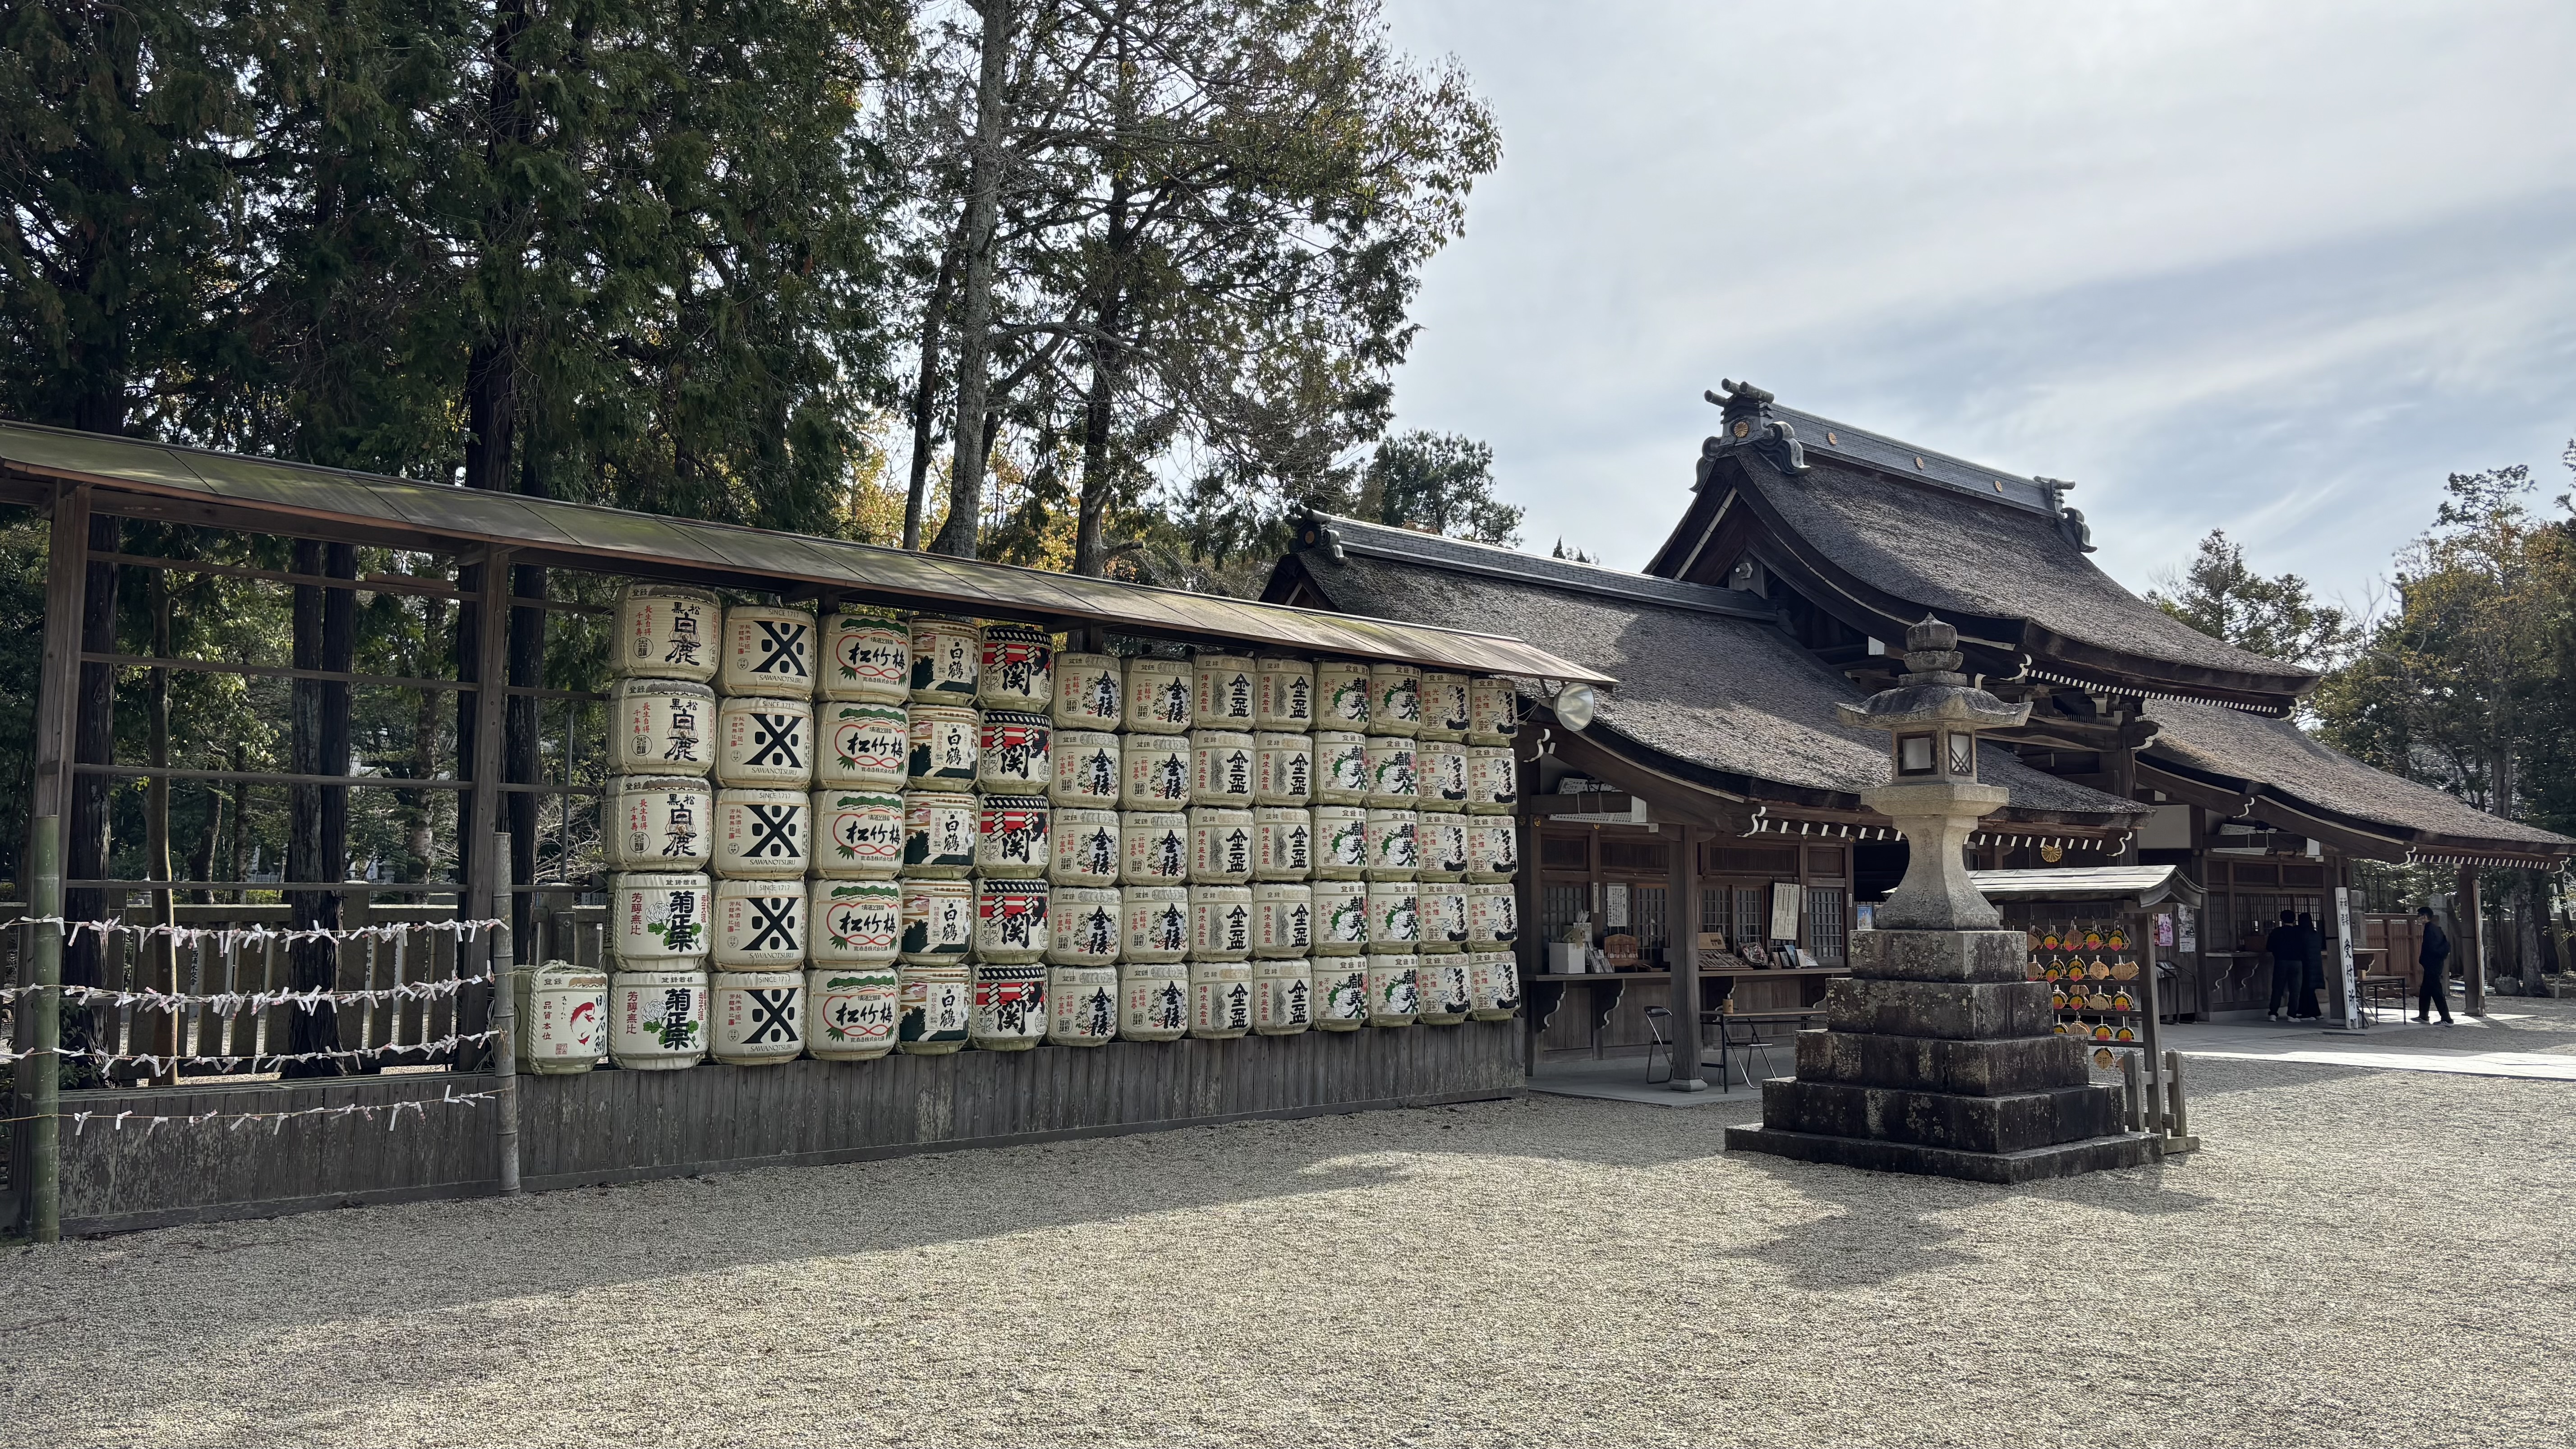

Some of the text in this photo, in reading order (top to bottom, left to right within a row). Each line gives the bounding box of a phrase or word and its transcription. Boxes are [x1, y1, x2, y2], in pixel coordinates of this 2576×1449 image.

[644, 605, 653, 636] 長生自得
[665, 612, 702, 666] 白鹿
[848, 642, 906, 671] 松竹梅
[948, 642, 964, 680] 白鶴
[759, 674, 803, 684] SAWANOTSURU
[1228, 673, 1251, 718] 金盃
[1289, 676, 1310, 719] 金盃
[1347, 677, 1367, 720] 都美人
[1398, 677, 1417, 719] 都美人
[642, 702, 651, 733] 長生自得
[664, 708, 699, 762] 白鹿
[846, 732, 904, 759] 松竹梅
[946, 727, 962, 766] 白鶴
[1348, 745, 1366, 789] 都美人
[751, 767, 797, 775] SAWANOTSURU
[1226, 749, 1249, 794] 金盃
[1288, 752, 1309, 796] 金盃
[1391, 751, 1413, 794] 都美人
[639, 798, 648, 830] 長生自得
[662, 803, 697, 856] 白鹿
[845, 820, 902, 846] 松竹梅
[943, 814, 960, 852] 白鶴
[1225, 827, 1248, 874] 金盃
[1288, 824, 1308, 869] 金盃
[1347, 820, 1365, 865] 都美人
[1396, 823, 1416, 866] 都美人
[630, 892, 643, 936] 芳醇無比
[668, 890, 695, 952] 菊正宗
[839, 911, 897, 935] 松竹梅
[942, 902, 958, 942] 白鶴
[1226, 904, 1248, 951] 金盃
[1290, 903, 1309, 948] 金盃
[1346, 896, 1366, 942] 都美人
[1401, 896, 1418, 940] 都美人
[1344, 972, 1364, 1019] 都美人
[1400, 968, 1417, 1013] 都美人
[2343, 938, 2355, 1010] 受付所
[542, 1001, 552, 1040] 品質本位
[626, 990, 639, 1035] 芳醇無比
[663, 988, 691, 1051] 菊正宗
[835, 1002, 893, 1026] 松竹梅
[939, 988, 956, 1028] 白鶴
[1227, 982, 1249, 1030] 金盃
[1288, 979, 1308, 1025] 金盃
[750, 1043, 794, 1052] SAWANOTSURU
